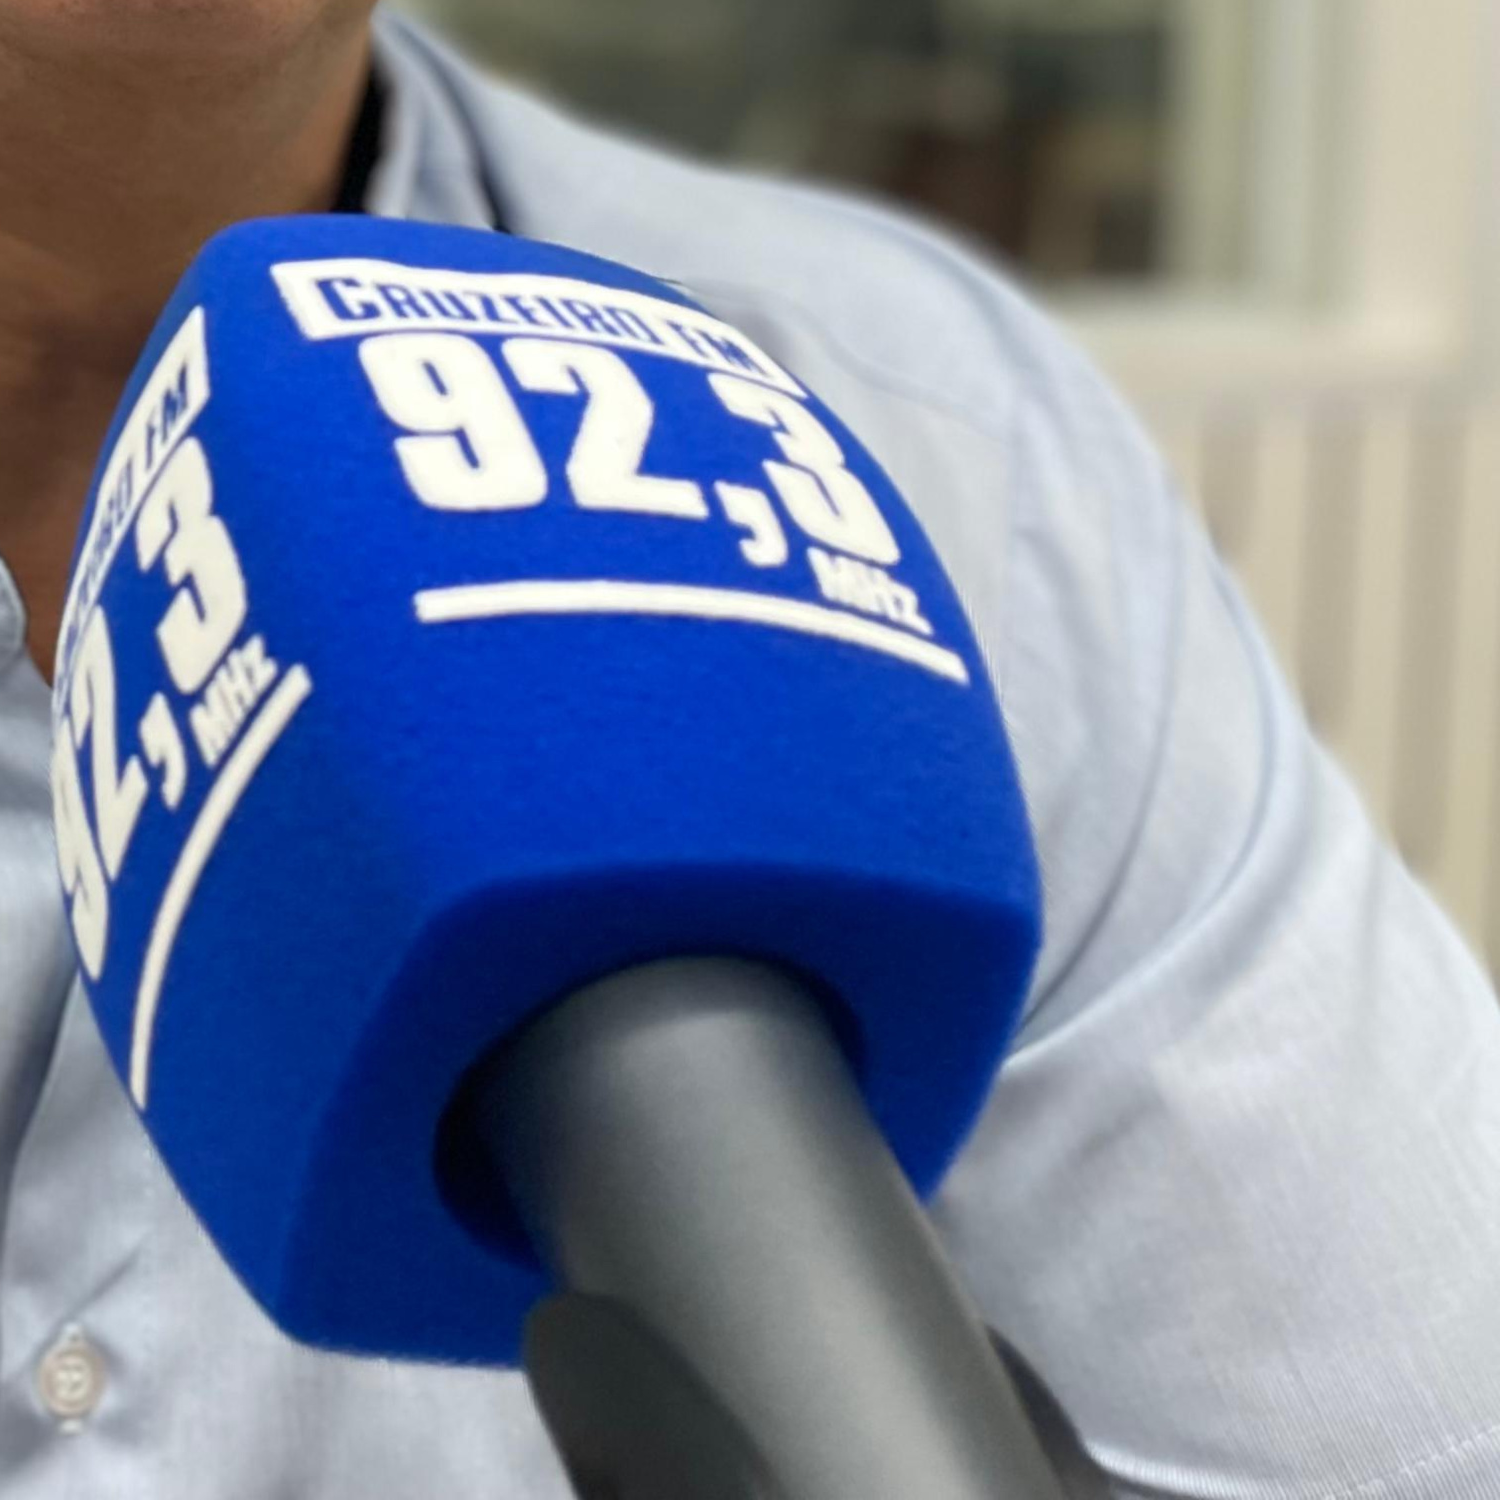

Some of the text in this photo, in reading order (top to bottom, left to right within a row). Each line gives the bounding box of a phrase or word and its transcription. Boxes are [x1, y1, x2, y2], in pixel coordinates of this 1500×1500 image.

[314, 277, 771, 379] CRUZEIRO FM
[357, 332, 901, 566] 92,3
